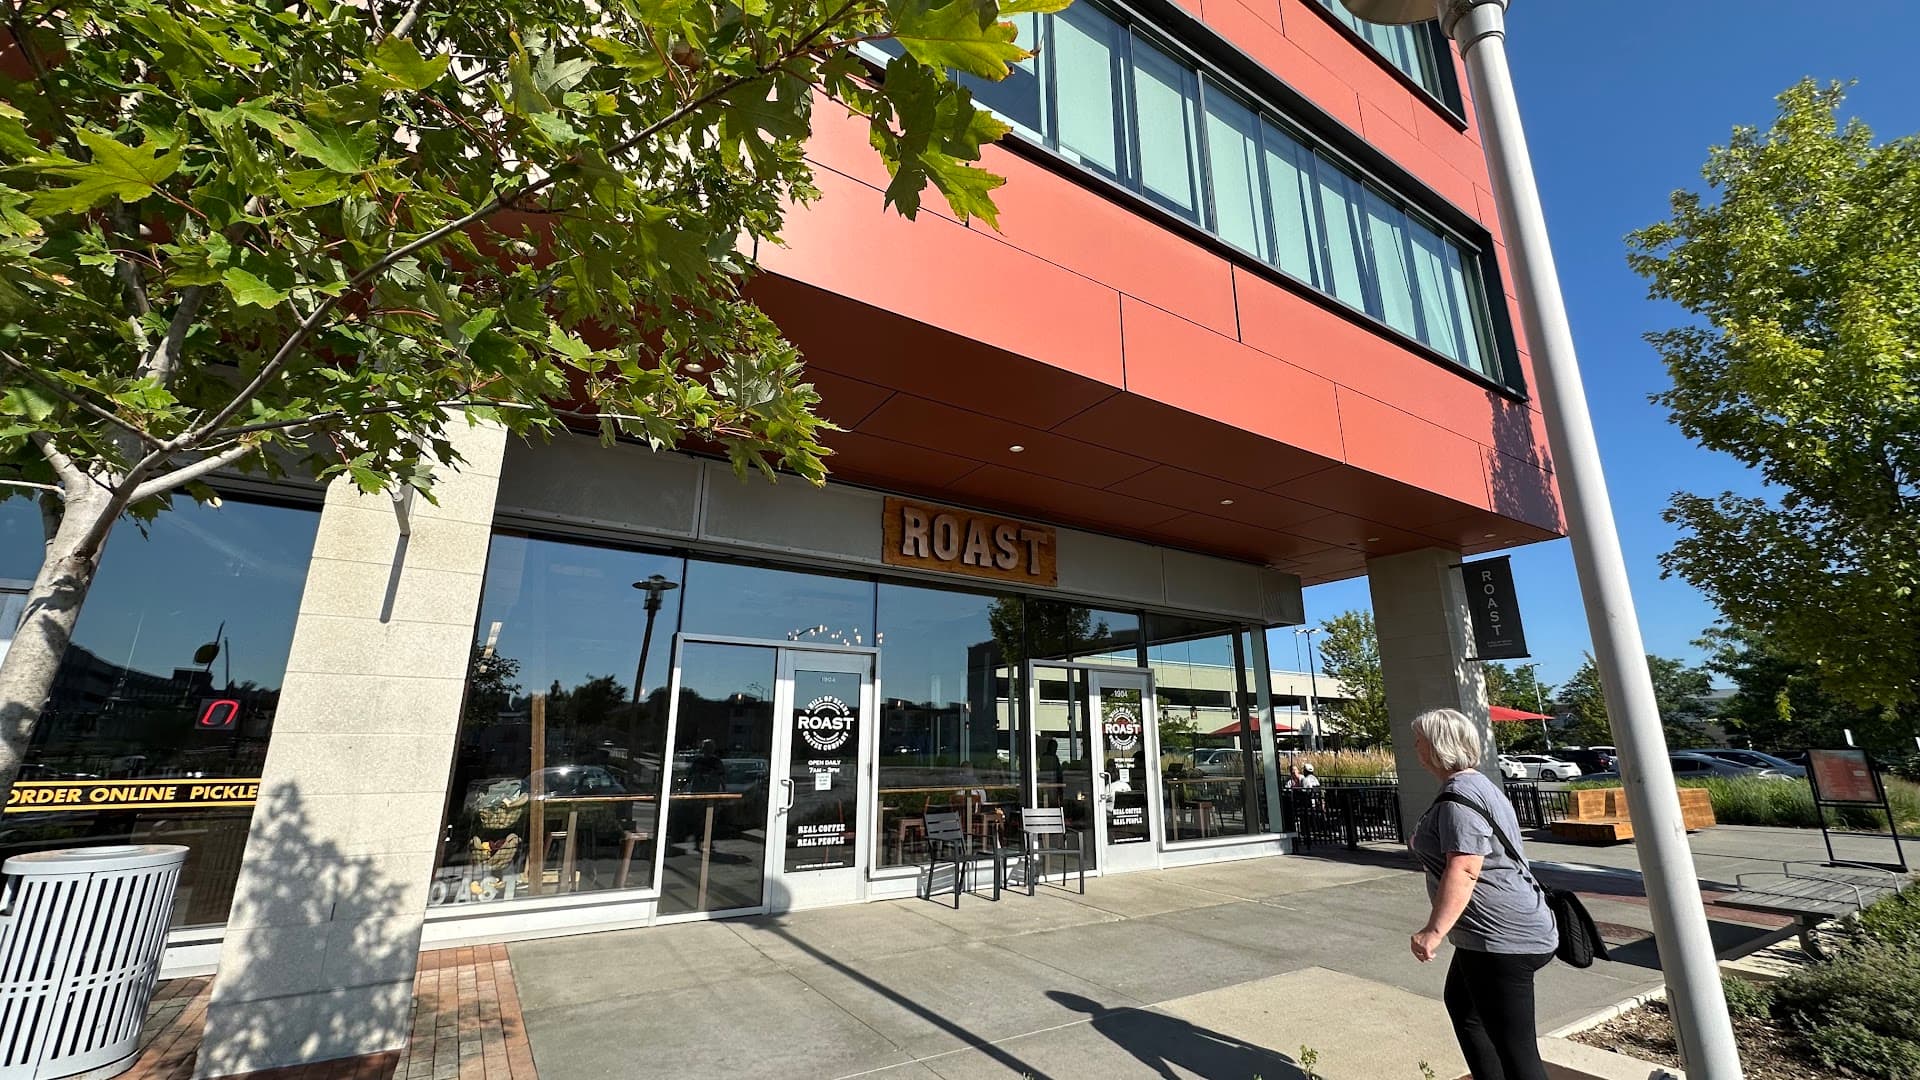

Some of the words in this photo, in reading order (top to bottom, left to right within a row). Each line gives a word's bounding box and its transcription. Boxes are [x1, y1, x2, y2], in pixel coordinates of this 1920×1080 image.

[903, 506, 1048, 575] ROAST
[1481, 570, 1502, 636] ROAST
[1114, 690, 1128, 698] 1904
[798, 716, 855, 730] ROAST
[1105, 723, 1140, 735] ROAST
[802, 730, 823, 751] COFFEE
[823, 731, 849, 751] COMPANY
[89, 786, 177, 803] ONLINE
[798, 825, 817, 834] REAL
[818, 824, 845, 832] COFFEE
[797, 838, 817, 847] REAL
[818, 837, 844, 846] PEOPLE
